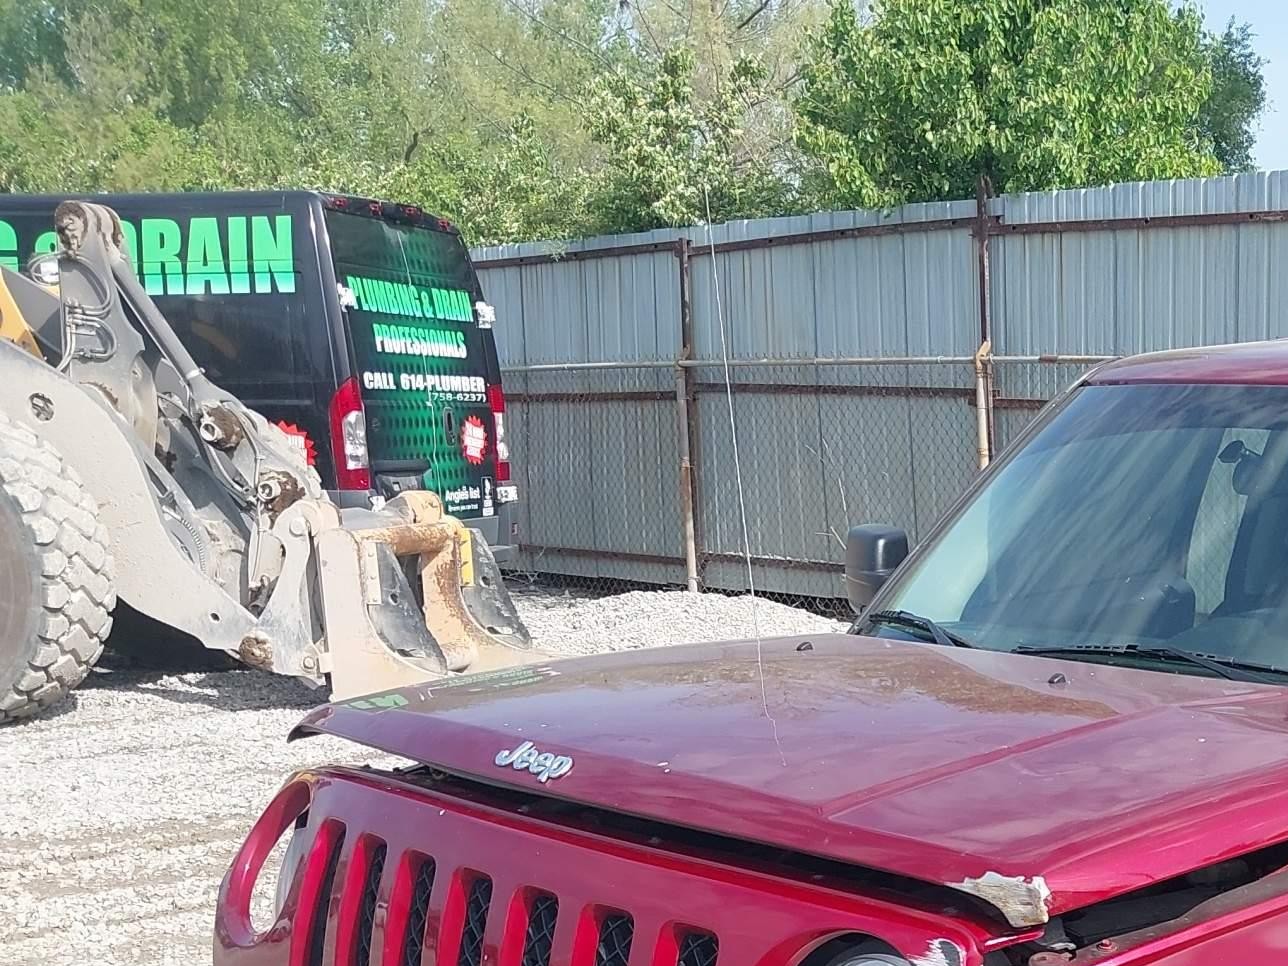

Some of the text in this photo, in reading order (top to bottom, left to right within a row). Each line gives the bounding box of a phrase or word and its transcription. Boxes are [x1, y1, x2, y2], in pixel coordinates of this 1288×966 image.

[347, 276, 474, 323] PLUMBING & DRAIN
[373, 323, 468, 359] PROFESSIONALS
[363, 371, 486, 393] CALL 614-PLUMBER
[429, 393, 487, 403] (758-6237)
[495, 741, 573, 783] Jeep
